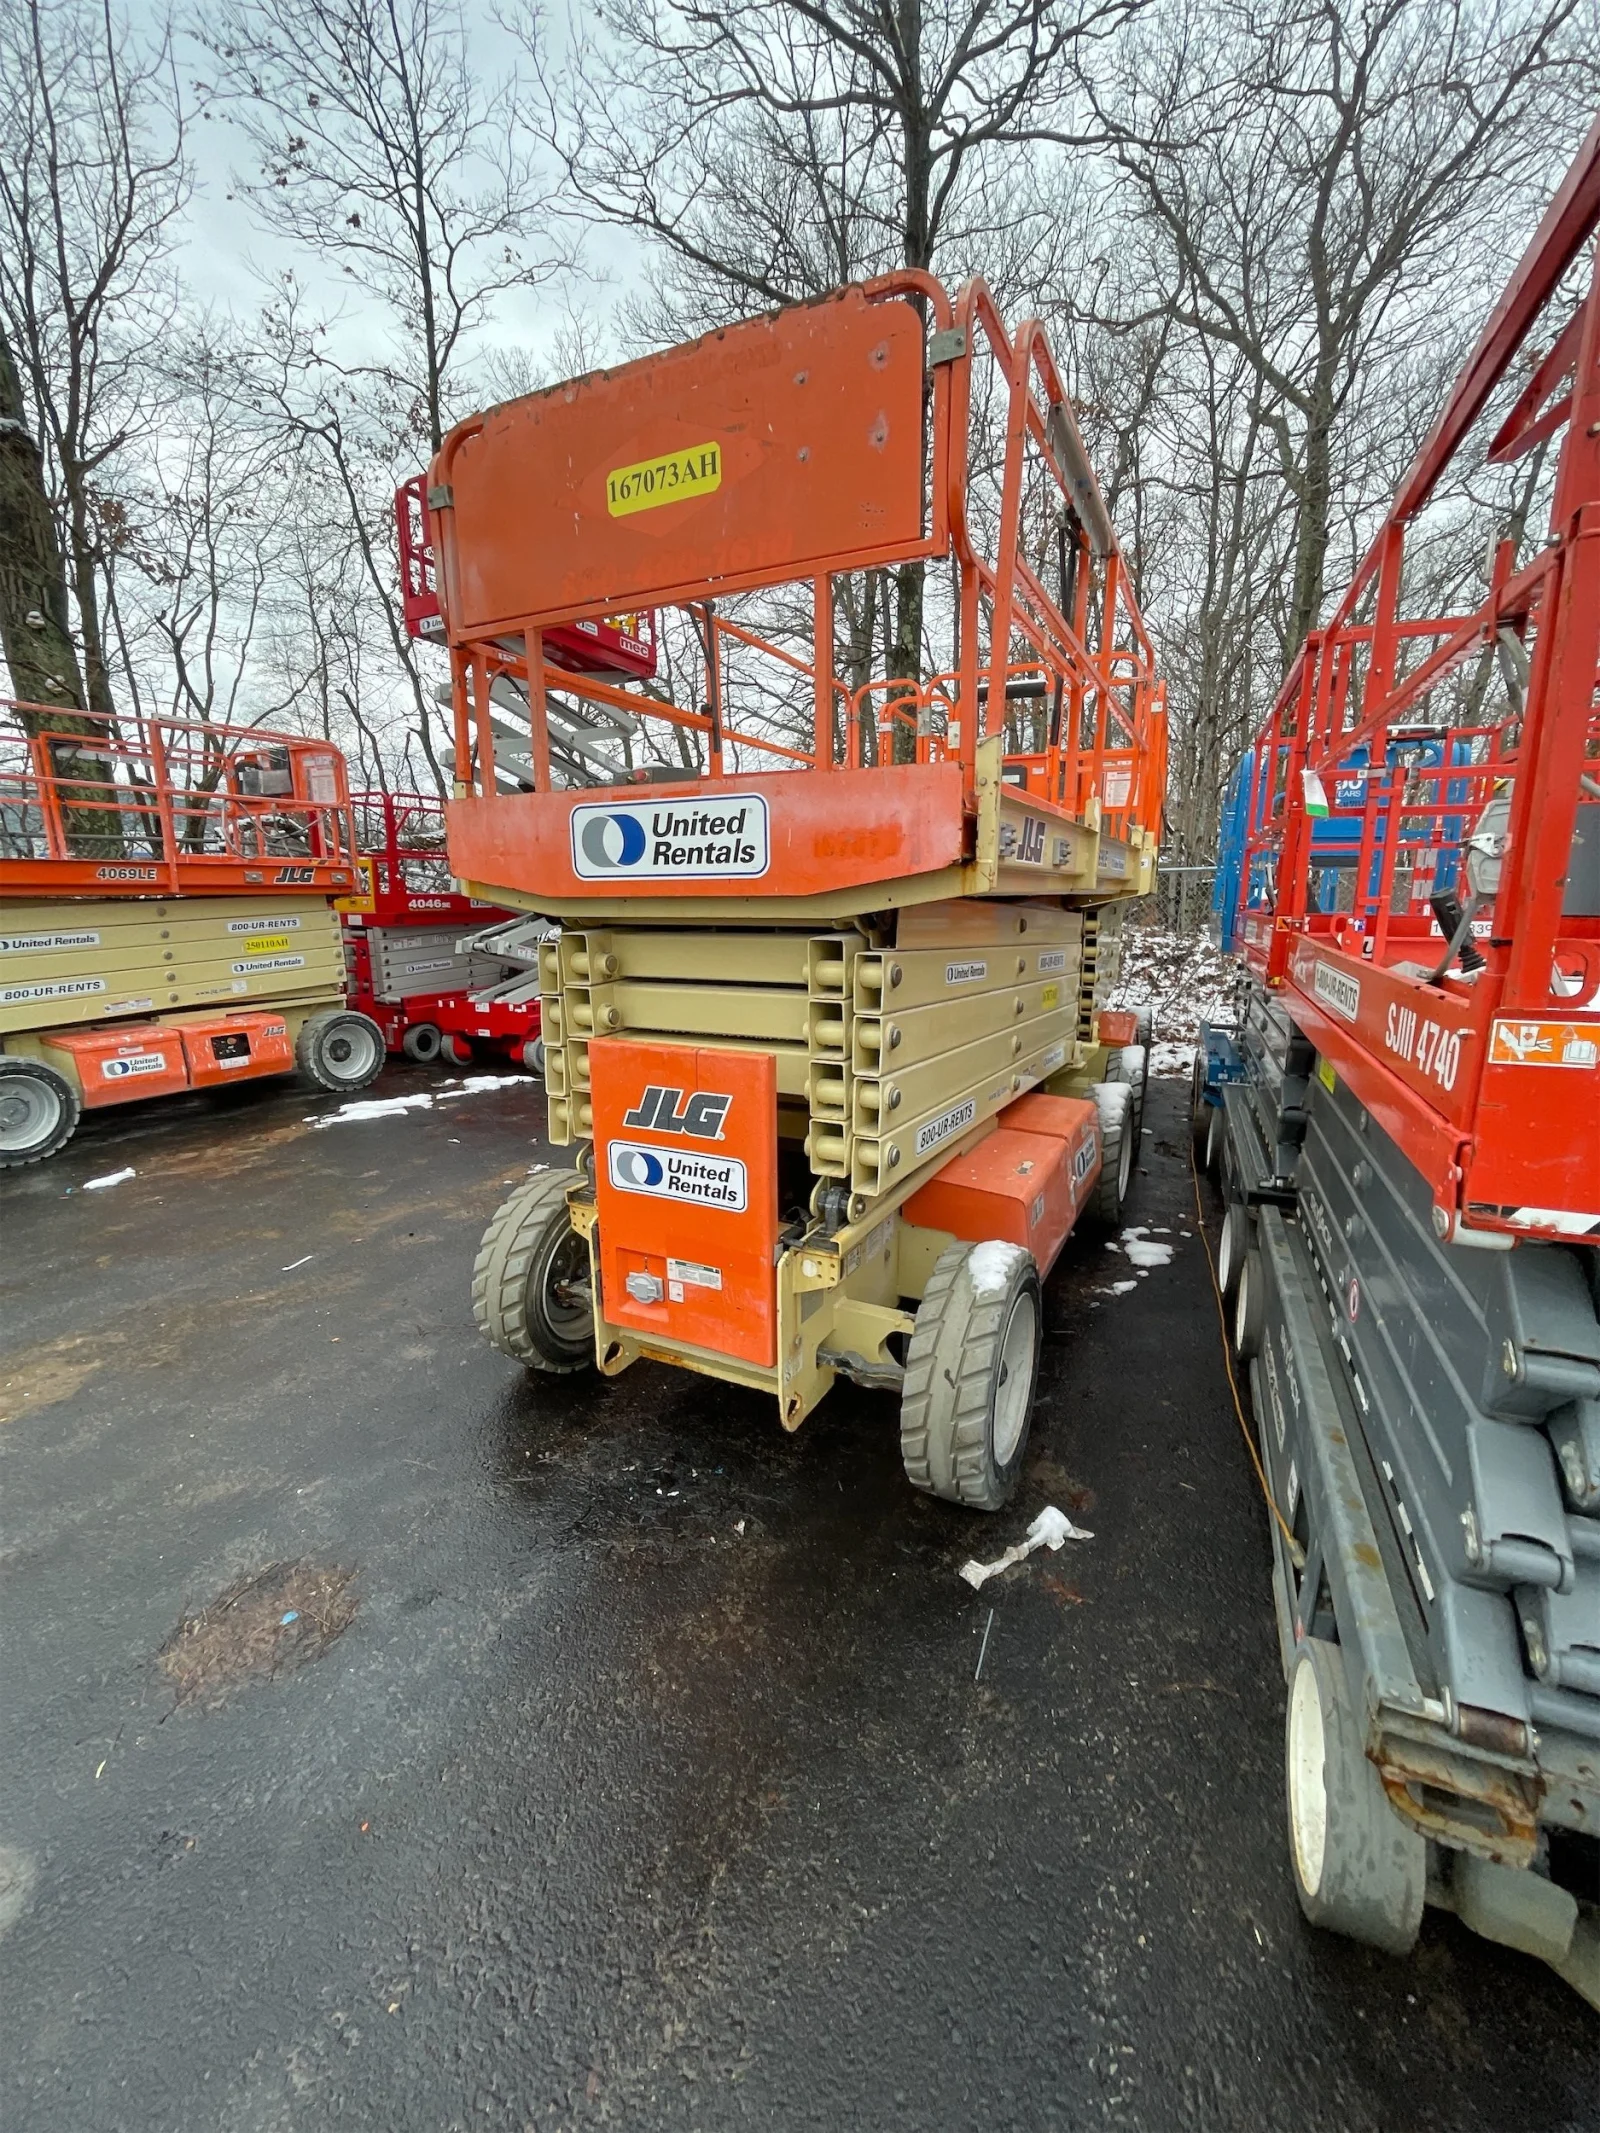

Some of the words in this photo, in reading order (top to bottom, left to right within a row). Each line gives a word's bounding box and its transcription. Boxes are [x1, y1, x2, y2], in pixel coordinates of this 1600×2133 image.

[608, 451, 719, 503] 167073AH
[621, 638, 648, 656] mec
[652, 808, 747, 838] United
[1016, 816, 1047, 865] JLG
[652, 838, 756, 866] Rentals
[97, 867, 156, 880] 4069LE
[274, 867, 316, 884] JLG
[231, 919, 298, 931] 800-UR-RENTS
[12, 938, 51, 949] United
[54, 935, 95, 946] Rentals
[245, 938, 288, 950] 250110AH
[246, 960, 272, 971] United
[274, 957, 302, 968] Rentals
[4, 981, 101, 1000] 800-UR-RENTS
[1385, 1002, 1417, 1062] SJIII
[1416, 1019, 1461, 1092] 4740
[129, 1055, 159, 1067] United
[131, 1062, 163, 1073] Rentals
[622, 1085, 733, 1140] JLG
[920, 1103, 973, 1147] 800-UR-RENTS
[668, 1158, 731, 1183] United
[668, 1175, 738, 1202] Rentals
